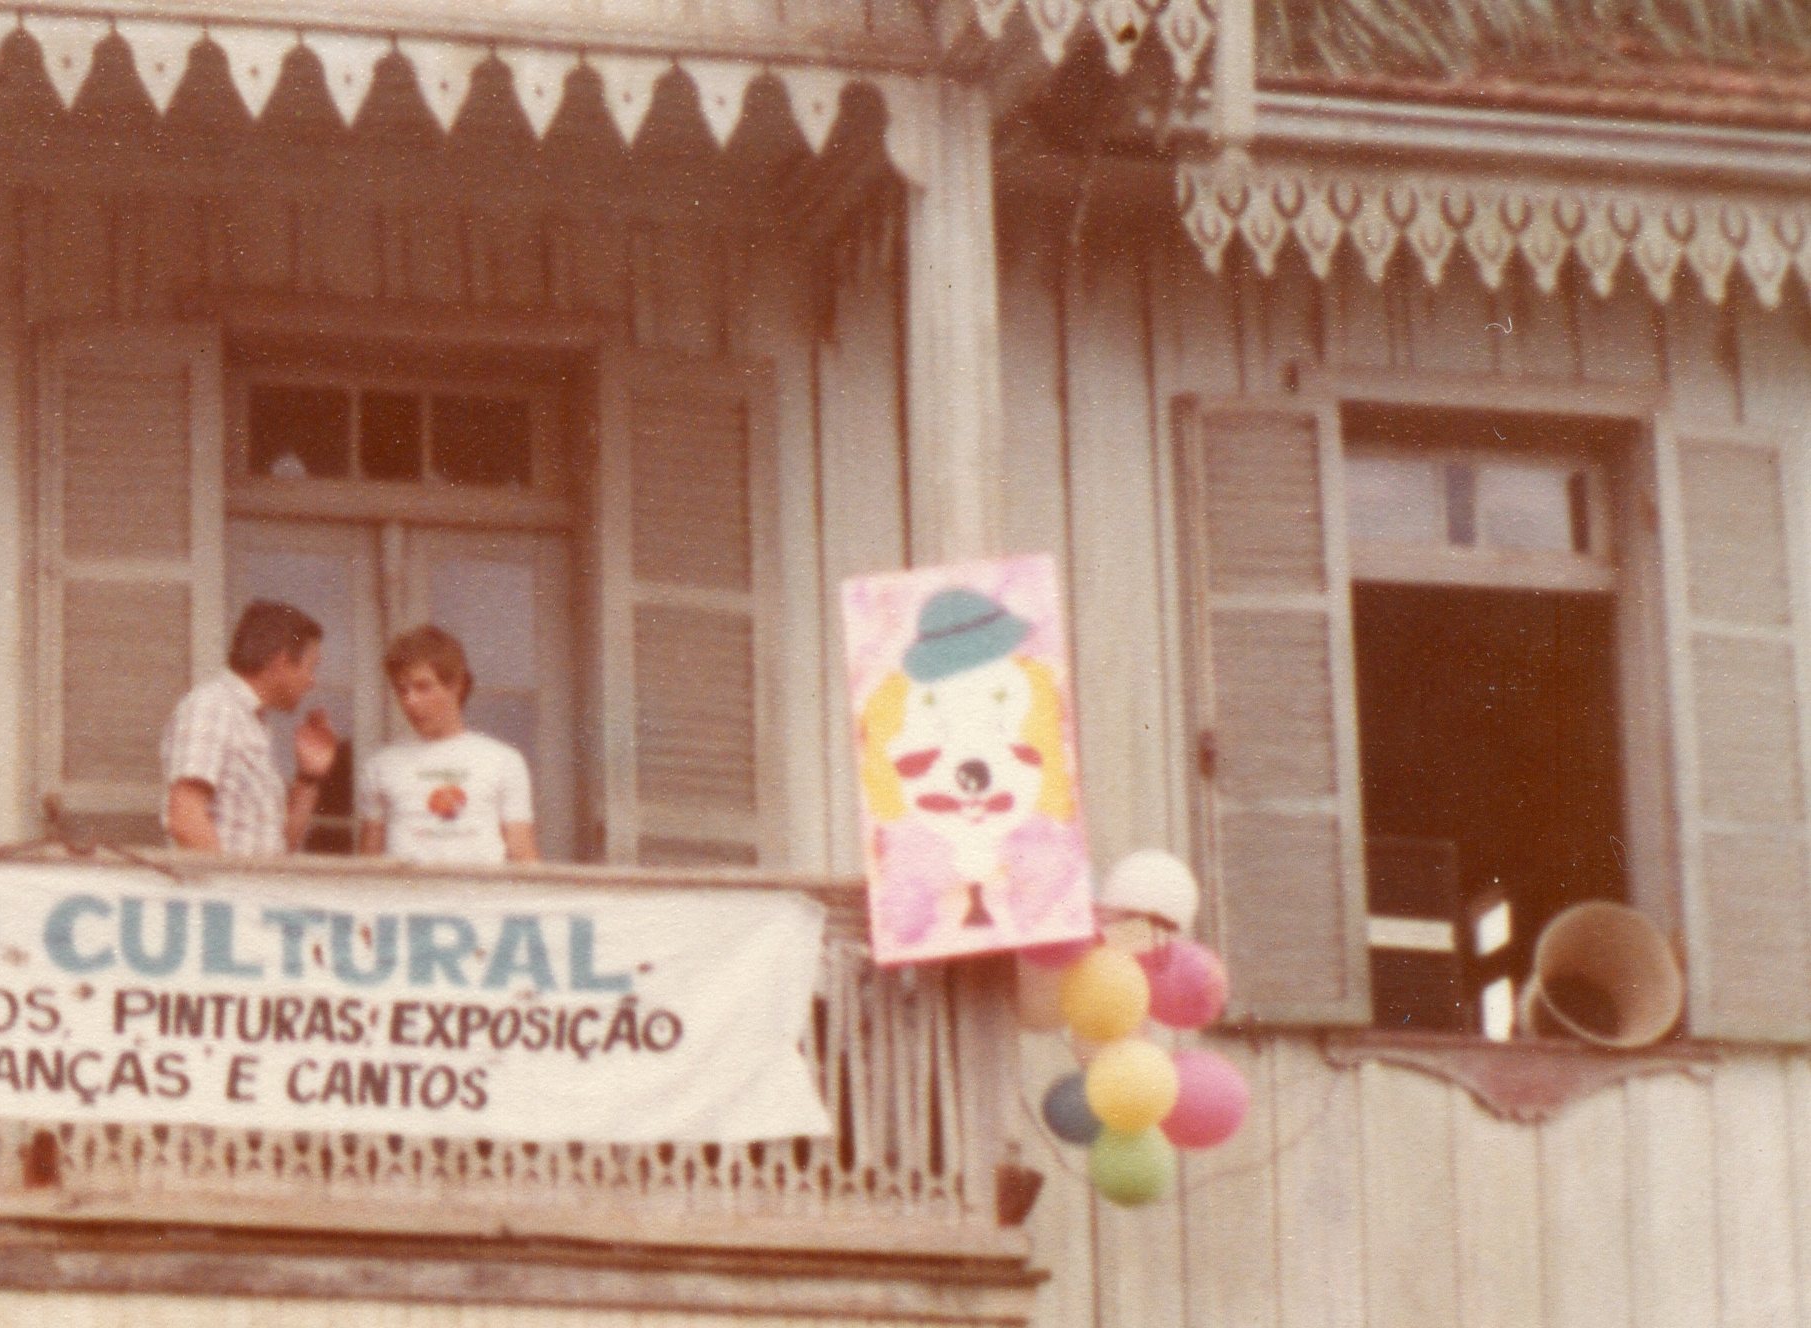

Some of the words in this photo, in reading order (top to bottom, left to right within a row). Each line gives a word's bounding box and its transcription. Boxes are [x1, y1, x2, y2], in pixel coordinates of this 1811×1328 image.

[44, 894, 632, 992] CULTURAL
[389, 994, 684, 1061] EXPOSIÇÃO
[225, 1054, 260, 1102] E
[286, 1057, 488, 1111] CANTOS
